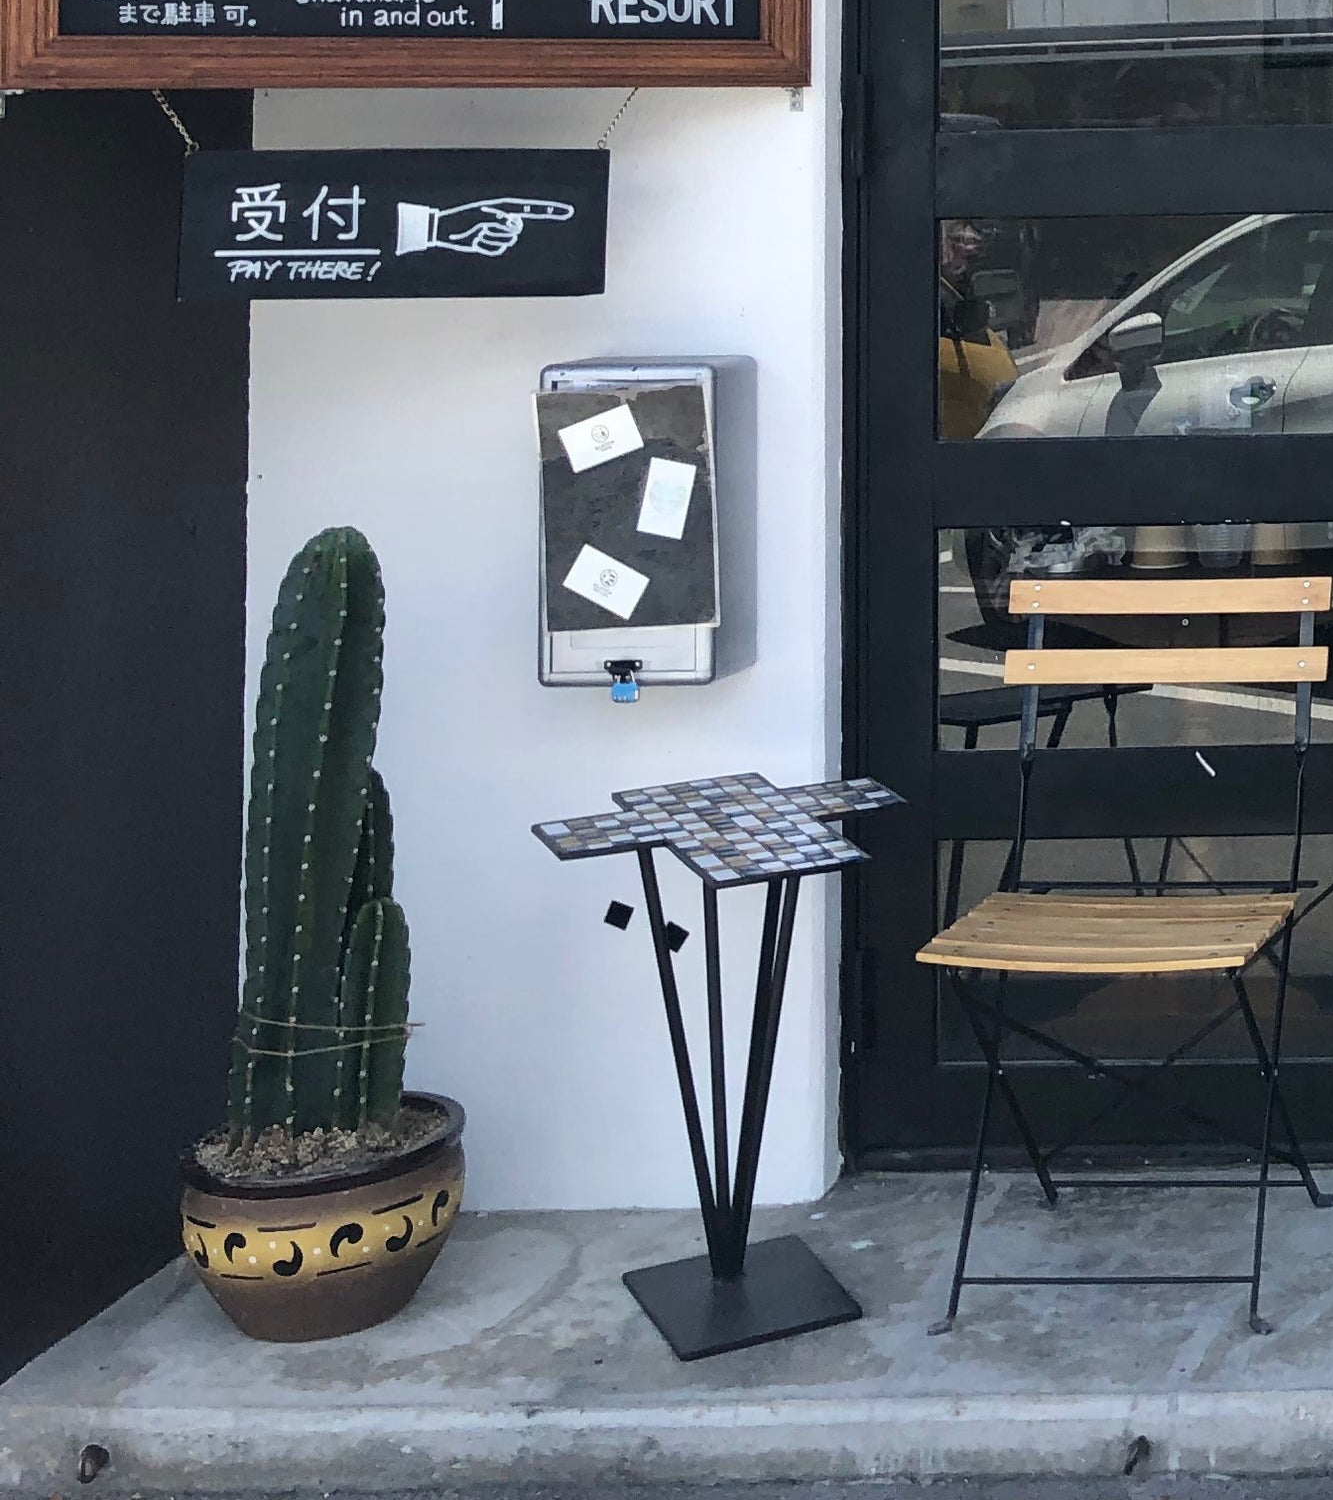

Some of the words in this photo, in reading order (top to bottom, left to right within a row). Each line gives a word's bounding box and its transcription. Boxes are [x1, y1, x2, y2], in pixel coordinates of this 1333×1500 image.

[340, 6, 363, 27] in
[374, 4, 421, 27] and
[426, 4, 476, 26] out.
[231, 182, 366, 242] 受付
[227, 260, 283, 282] PAY
[287, 259, 381, 282] THERE!
